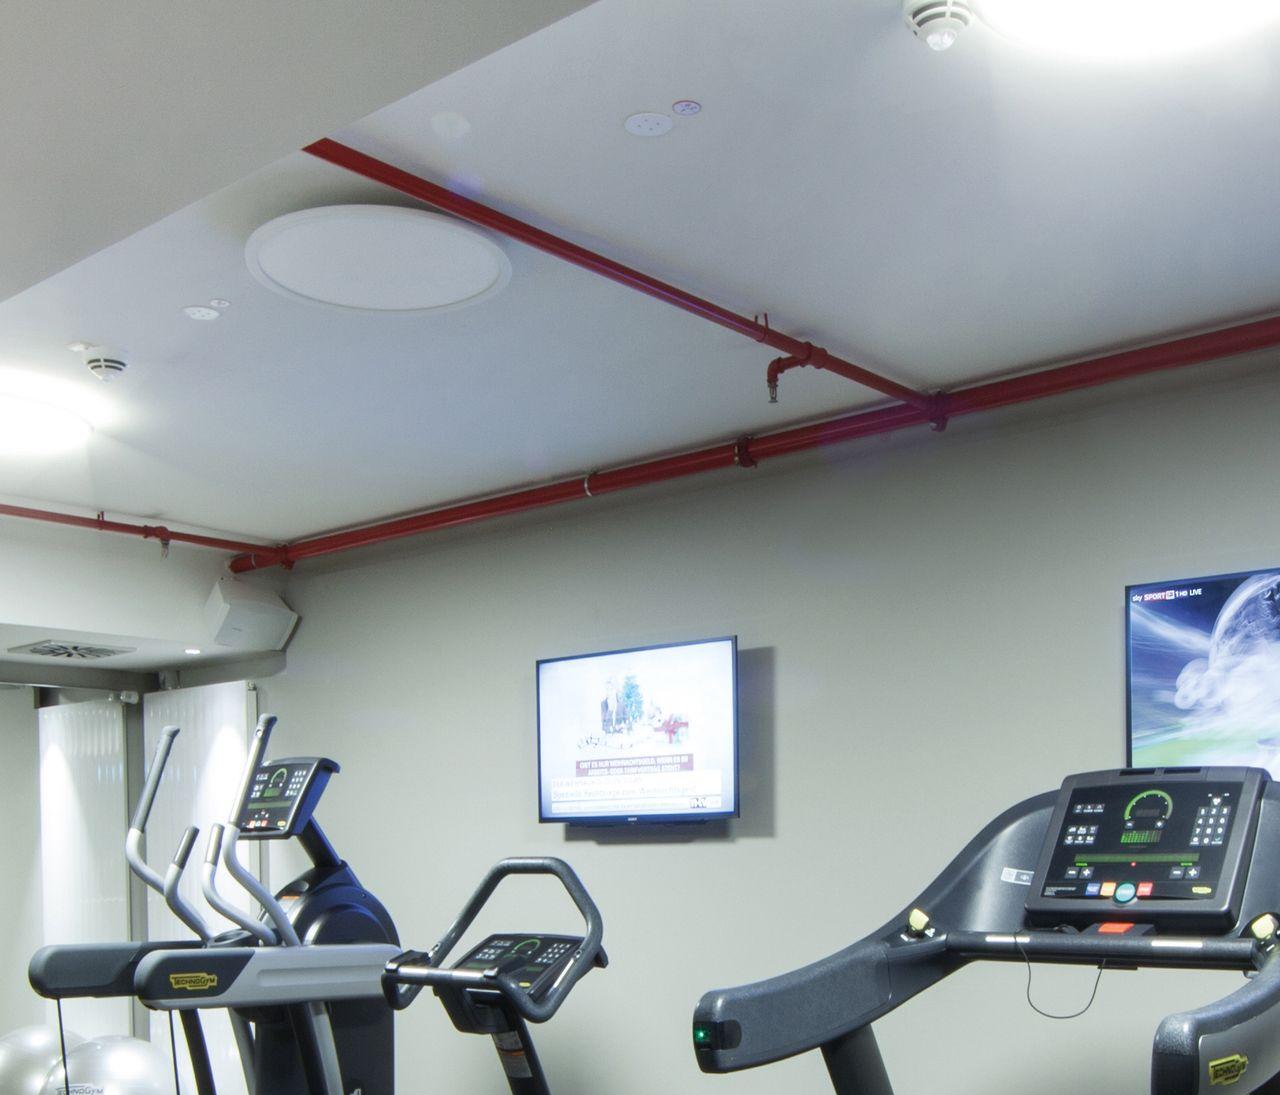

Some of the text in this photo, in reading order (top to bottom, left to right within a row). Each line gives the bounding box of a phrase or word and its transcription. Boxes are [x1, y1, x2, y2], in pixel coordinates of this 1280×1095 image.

[1144, 591, 1166, 601] SPORT
[1189, 588, 1203, 596] LIVE
[171, 975, 216, 987] TECHNOGYM
